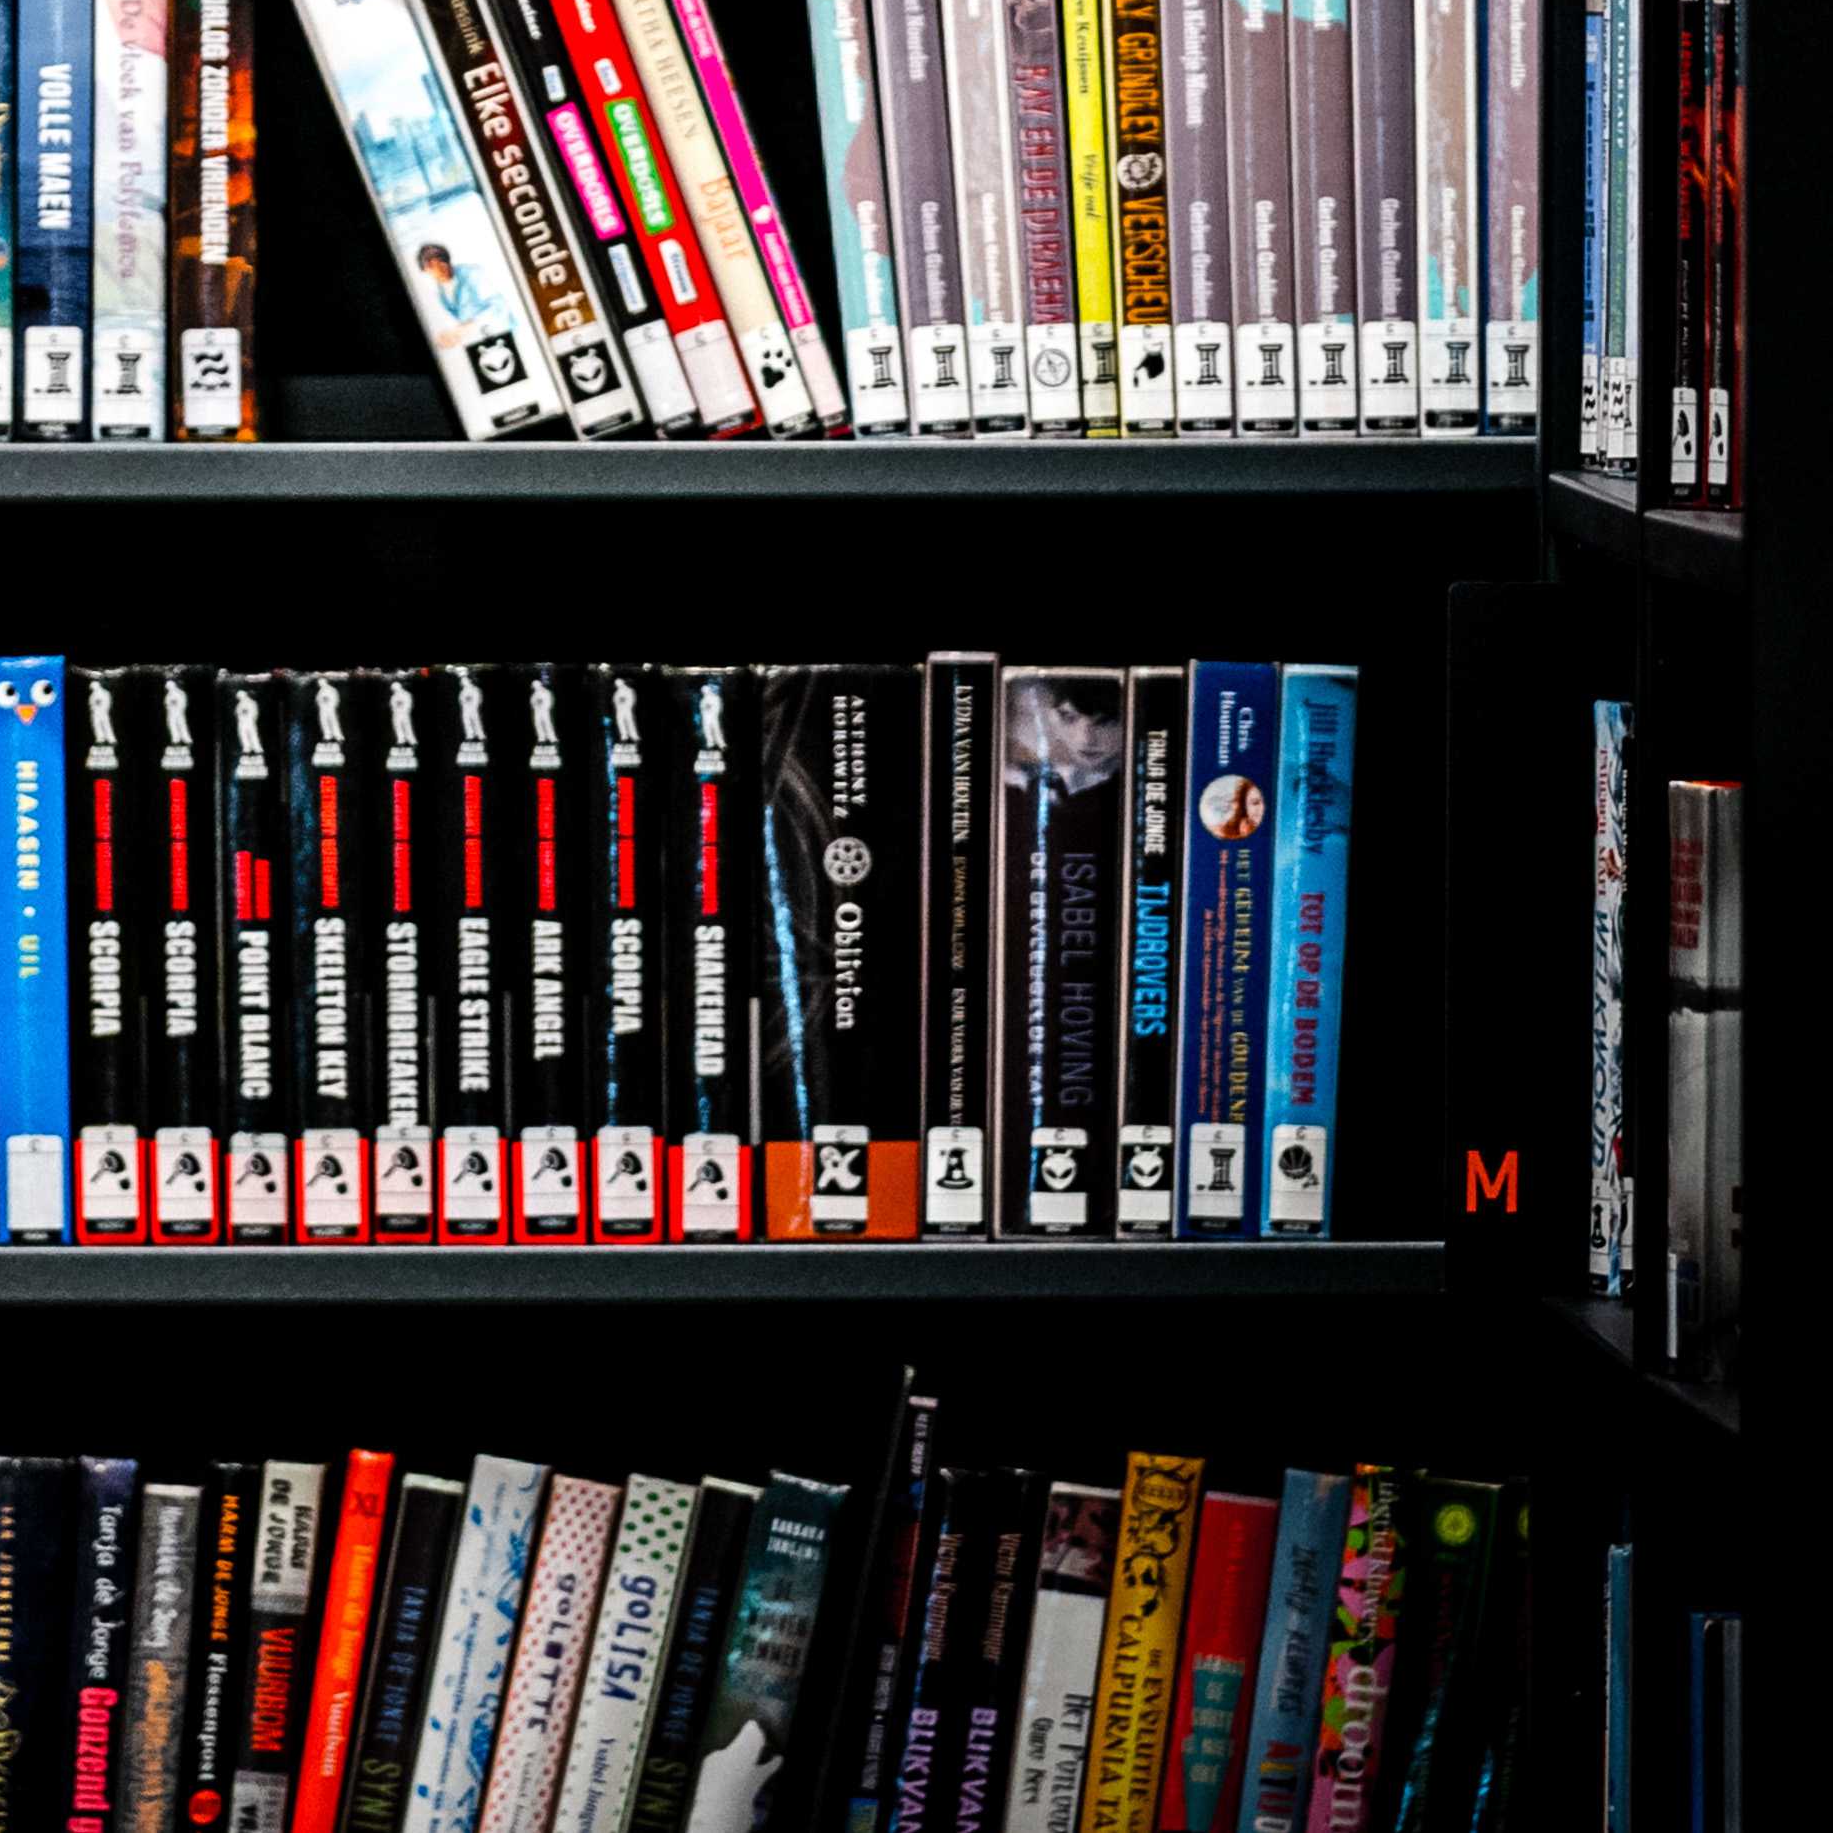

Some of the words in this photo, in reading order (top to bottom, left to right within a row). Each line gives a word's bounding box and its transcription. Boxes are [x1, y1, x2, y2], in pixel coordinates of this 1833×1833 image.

[37, 63, 73, 146] VOLLE
[201, 64, 229, 151] ZONDER
[1115, 32, 1161, 144] GRINDLEY
[35, 152, 71, 231] MAEN
[200, 154, 229, 264] VRIENDEN
[462, 60, 511, 140] Elke
[491, 143, 571, 286] seconde
[850, 695, 866, 808] ANTHONY
[952, 685, 974, 734] LYDIA
[1304, 698, 1339, 735] Jill
[832, 695, 849, 820] HOROWITZ
[952, 737, 974, 775] VAN
[1144, 729, 1168, 779] TANJA
[15, 761, 40, 891] HIAASEN
[952, 776, 973, 843] HOUTEN
[532, 920, 562, 975] ARK
[1059, 851, 1097, 966] ISABEL
[1300, 892, 1325, 934] TOT
[88, 921, 122, 1037] SCORPIA
[164, 921, 197, 1038] SCORPIA
[238, 930, 271, 1011] POINT
[313, 918, 347, 1046] SKELETON
[458, 917, 489, 994] EAGLE
[610, 919, 643, 1035] SCORPIA
[834, 902, 864, 1030] Oblivion
[1134, 881, 1172, 1038] TIJDROVERS
[1296, 979, 1321, 1008] DE
[1299, 942, 1323, 974] OP
[533, 978, 563, 1060] ANGEL
[694, 925, 726, 1077] SNAKEHEAD
[241, 1014, 272, 1100] BLANC
[315, 1050, 347, 1099] KEY
[459, 998, 490, 1092] STRIKE
[1058, 981, 1096, 1108] HOVING
[1291, 1017, 1319, 1107] BODEM
[1467, 1149, 1519, 1214] M
[92, 1505, 123, 1567] Tanja
[218, 1493, 240, 1553] HARM
[87, 1617, 121, 1680] Jonge
[211, 1586, 232, 1642] JONGE
[197, 1652, 228, 1782] Flessenpost
[1099, 1613, 1144, 1784] CALPURNIA
[71, 1686, 119, 1811] Gonzend
